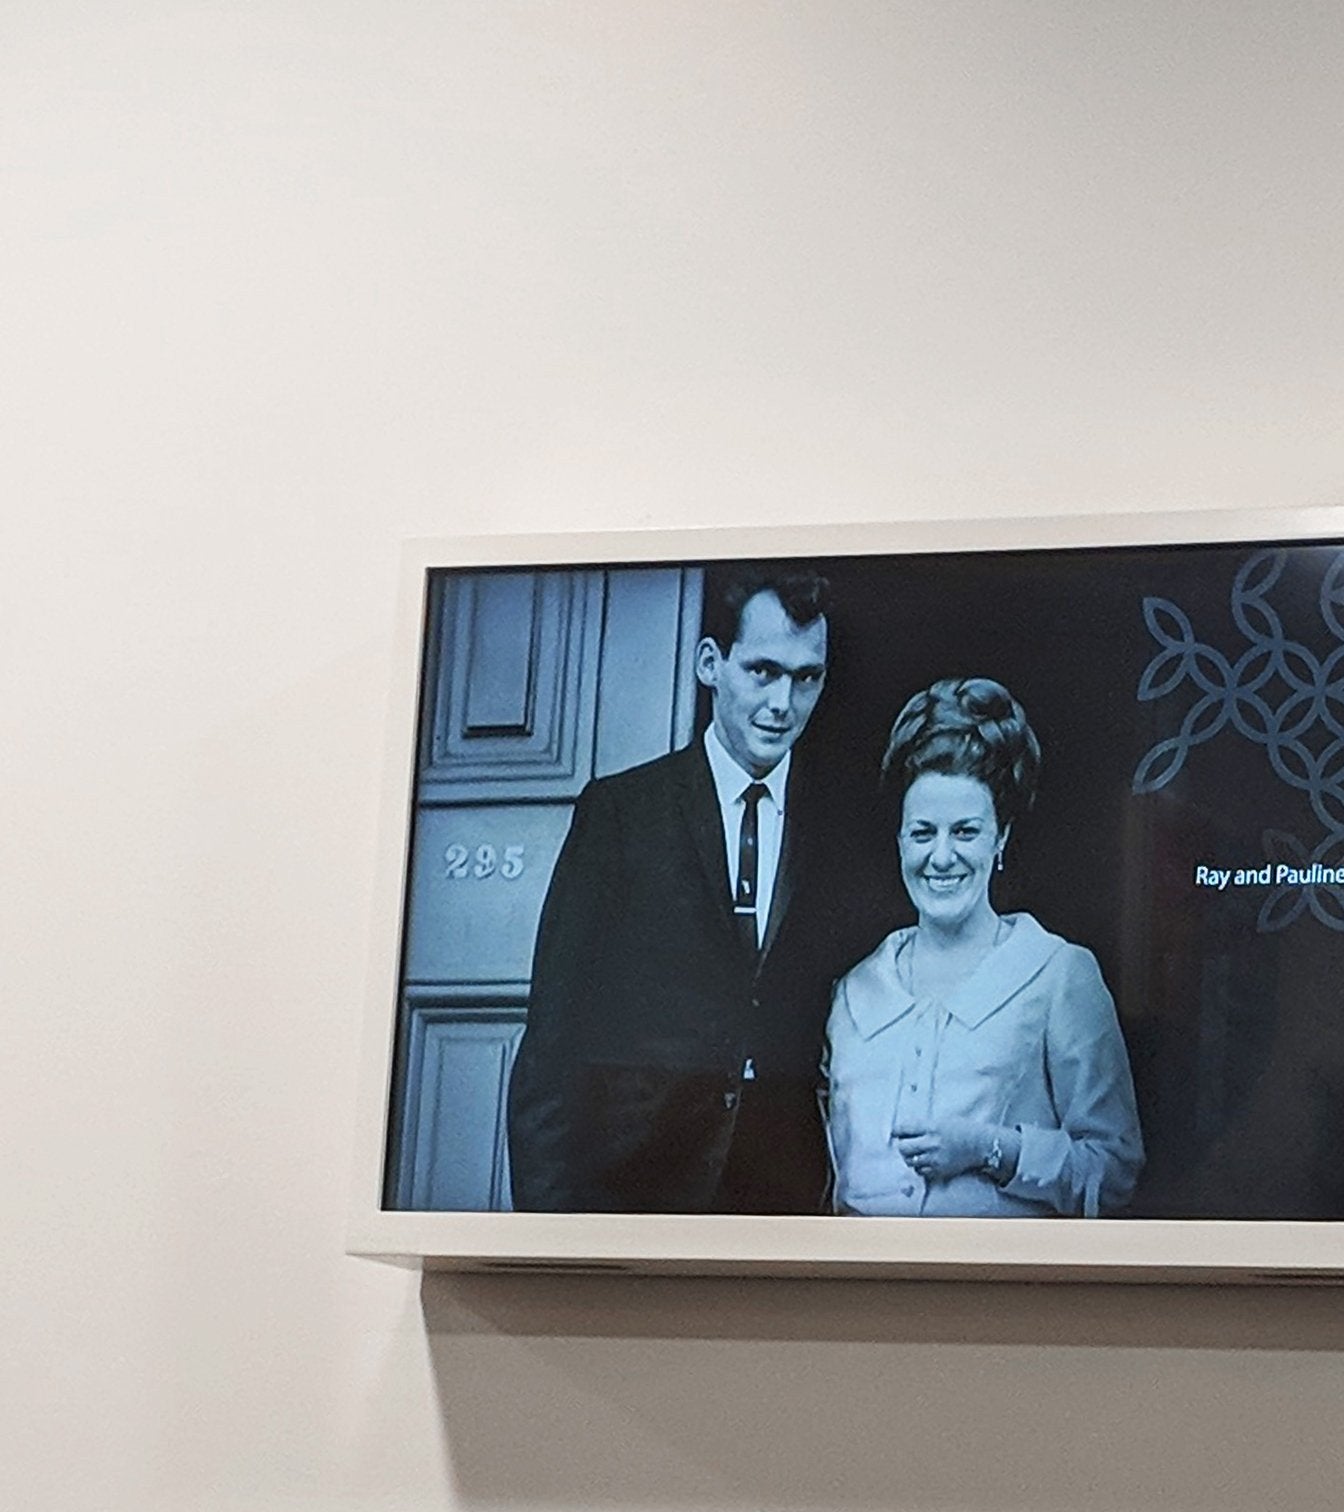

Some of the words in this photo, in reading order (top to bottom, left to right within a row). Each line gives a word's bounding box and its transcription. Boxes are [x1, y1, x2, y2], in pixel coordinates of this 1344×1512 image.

[445, 843, 524, 879] 295
[1195, 865, 1232, 891] Ray
[1233, 863, 1272, 885] and
